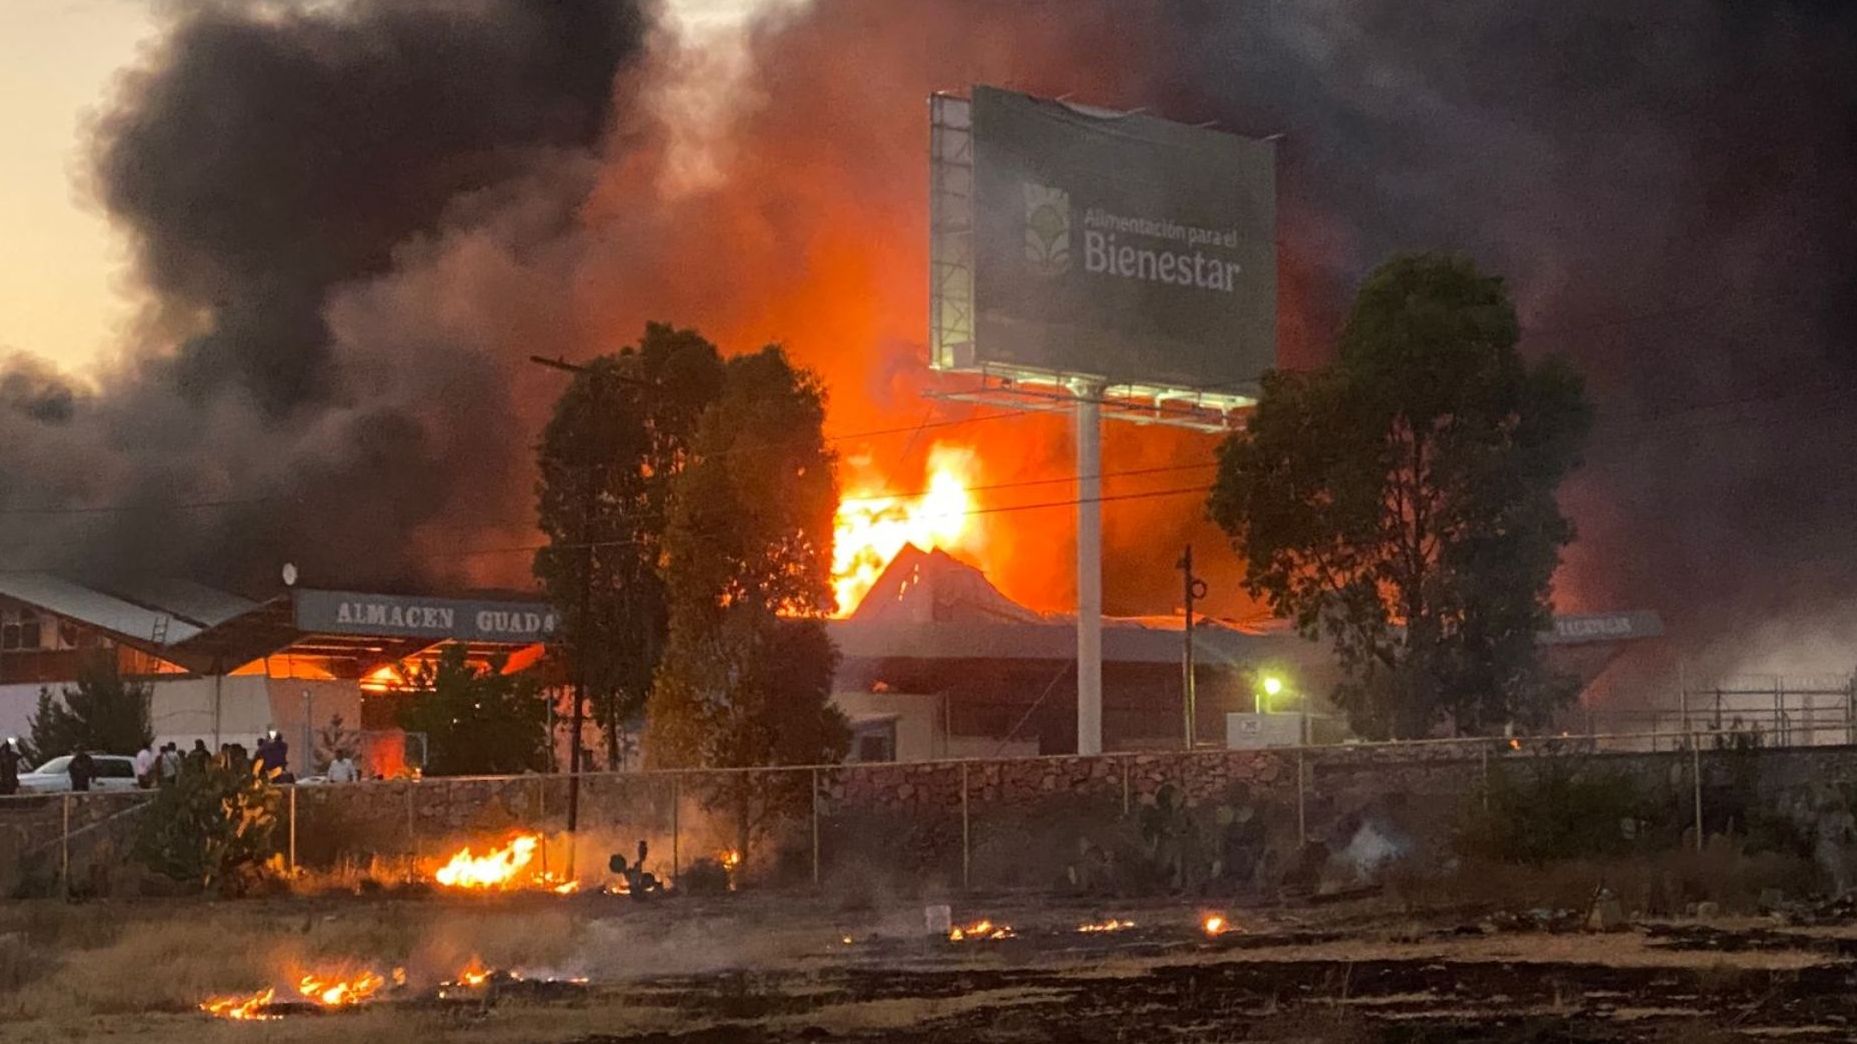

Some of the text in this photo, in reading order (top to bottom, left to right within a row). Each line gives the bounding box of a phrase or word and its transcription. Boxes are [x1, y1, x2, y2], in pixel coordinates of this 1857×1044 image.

[1084, 208, 1238, 248] Alimentación para el
[1084, 229, 1241, 292] Bienestar
[336, 602, 455, 629] ALMACEN
